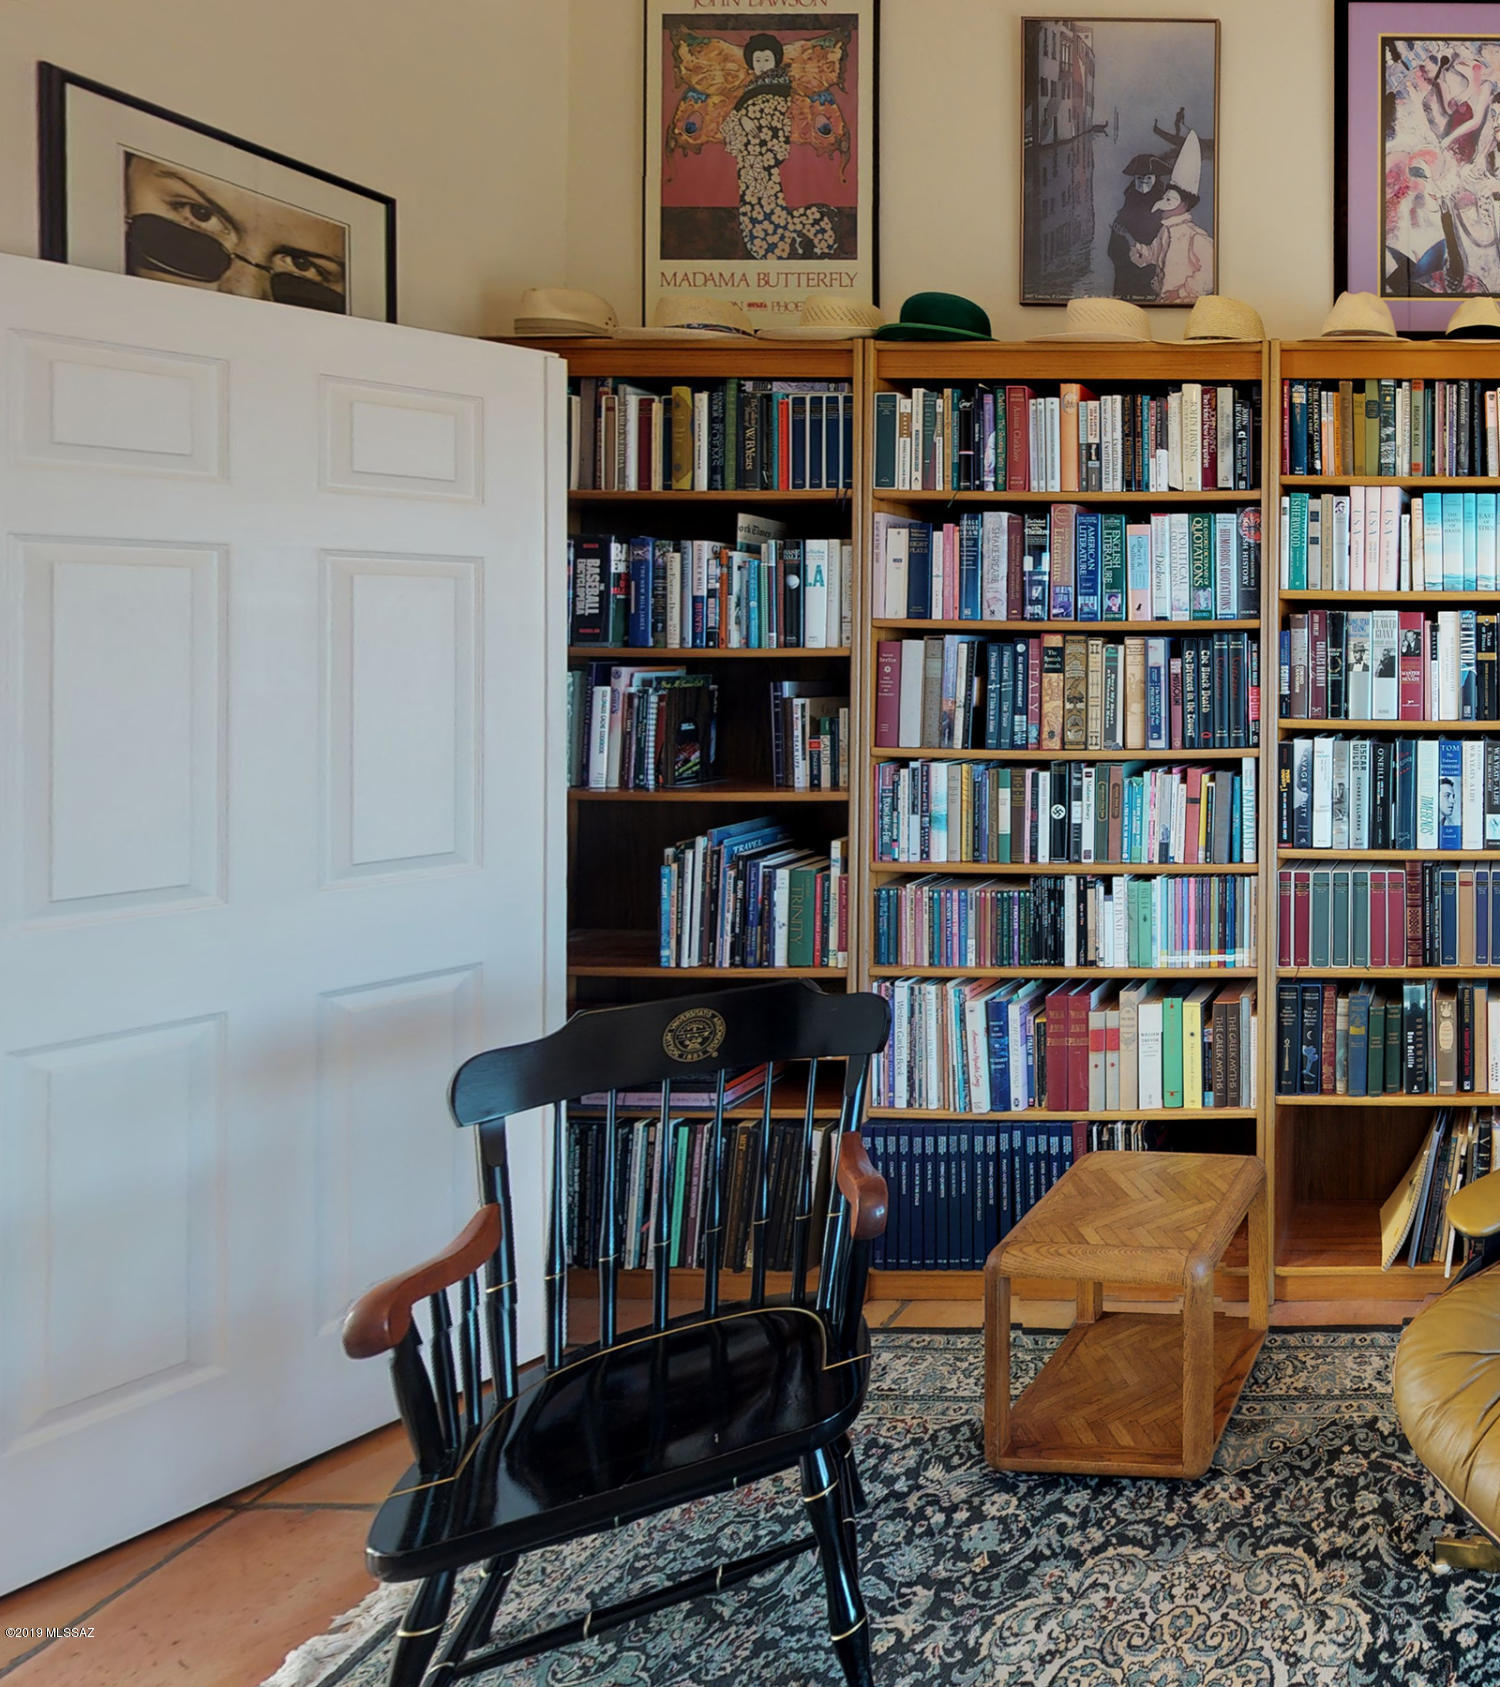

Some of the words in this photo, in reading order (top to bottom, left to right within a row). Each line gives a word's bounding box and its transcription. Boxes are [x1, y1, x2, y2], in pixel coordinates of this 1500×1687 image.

[660, 271, 751, 288] MADAMA
[756, 271, 858, 288] BUTTERFLY
[1190, 401, 1198, 426] JOHN
[1460, 381, 1469, 424] Frankenstein
[1190, 429, 1198, 462] IRVING
[1202, 436, 1210, 468] Hampshire
[1291, 497, 1301, 547] ISHERWOOD
[991, 526, 1000, 584] SHAKESPEARE
[1053, 527, 1064, 582] Literature
[1080, 525, 1088, 575] LITERATURE
[1104, 529, 1112, 583] LITERATURE
[1112, 529, 1120, 569] ENGLISH
[1179, 531, 1187, 585] POLITICAL
[1193, 517, 1204, 587] QUOTATIONS
[1219, 528, 1231, 567] HUMOROUS
[576, 558, 586, 615] ENCYCLOPEDIA
[586, 558, 600, 615] BASEBALL
[1155, 554, 1165, 591] Dickens
[1219, 567, 1231, 611] QUOTATIONS
[694, 602, 703, 633] BUNTS
[1201, 650, 1211, 666] The
[1460, 631, 1476, 672] LINCOLN
[1030, 659, 1038, 712] ITALY
[1201, 668, 1211, 690] Black
[1201, 691, 1211, 713] Death
[821, 736, 830, 765] GAUDI
[1352, 744, 1360, 771] WILDE
[1244, 788, 1255, 852] NATURALIST
[733, 839, 763, 853] TRAVEL
[791, 883, 805, 944] TRINITY
[897, 1000, 905, 1027] Western
[1216, 1016, 1224, 1030] THE
[1229, 1016, 1237, 1030] THE
[897, 1028, 905, 1056] Garden
[1216, 1031, 1224, 1056] GREEK
[1229, 1031, 1237, 1056] GREEK
[897, 1058, 905, 1076] Book
[1216, 1058, 1224, 1088] MYTHS
[1229, 1058, 1237, 1087] MYTHS
